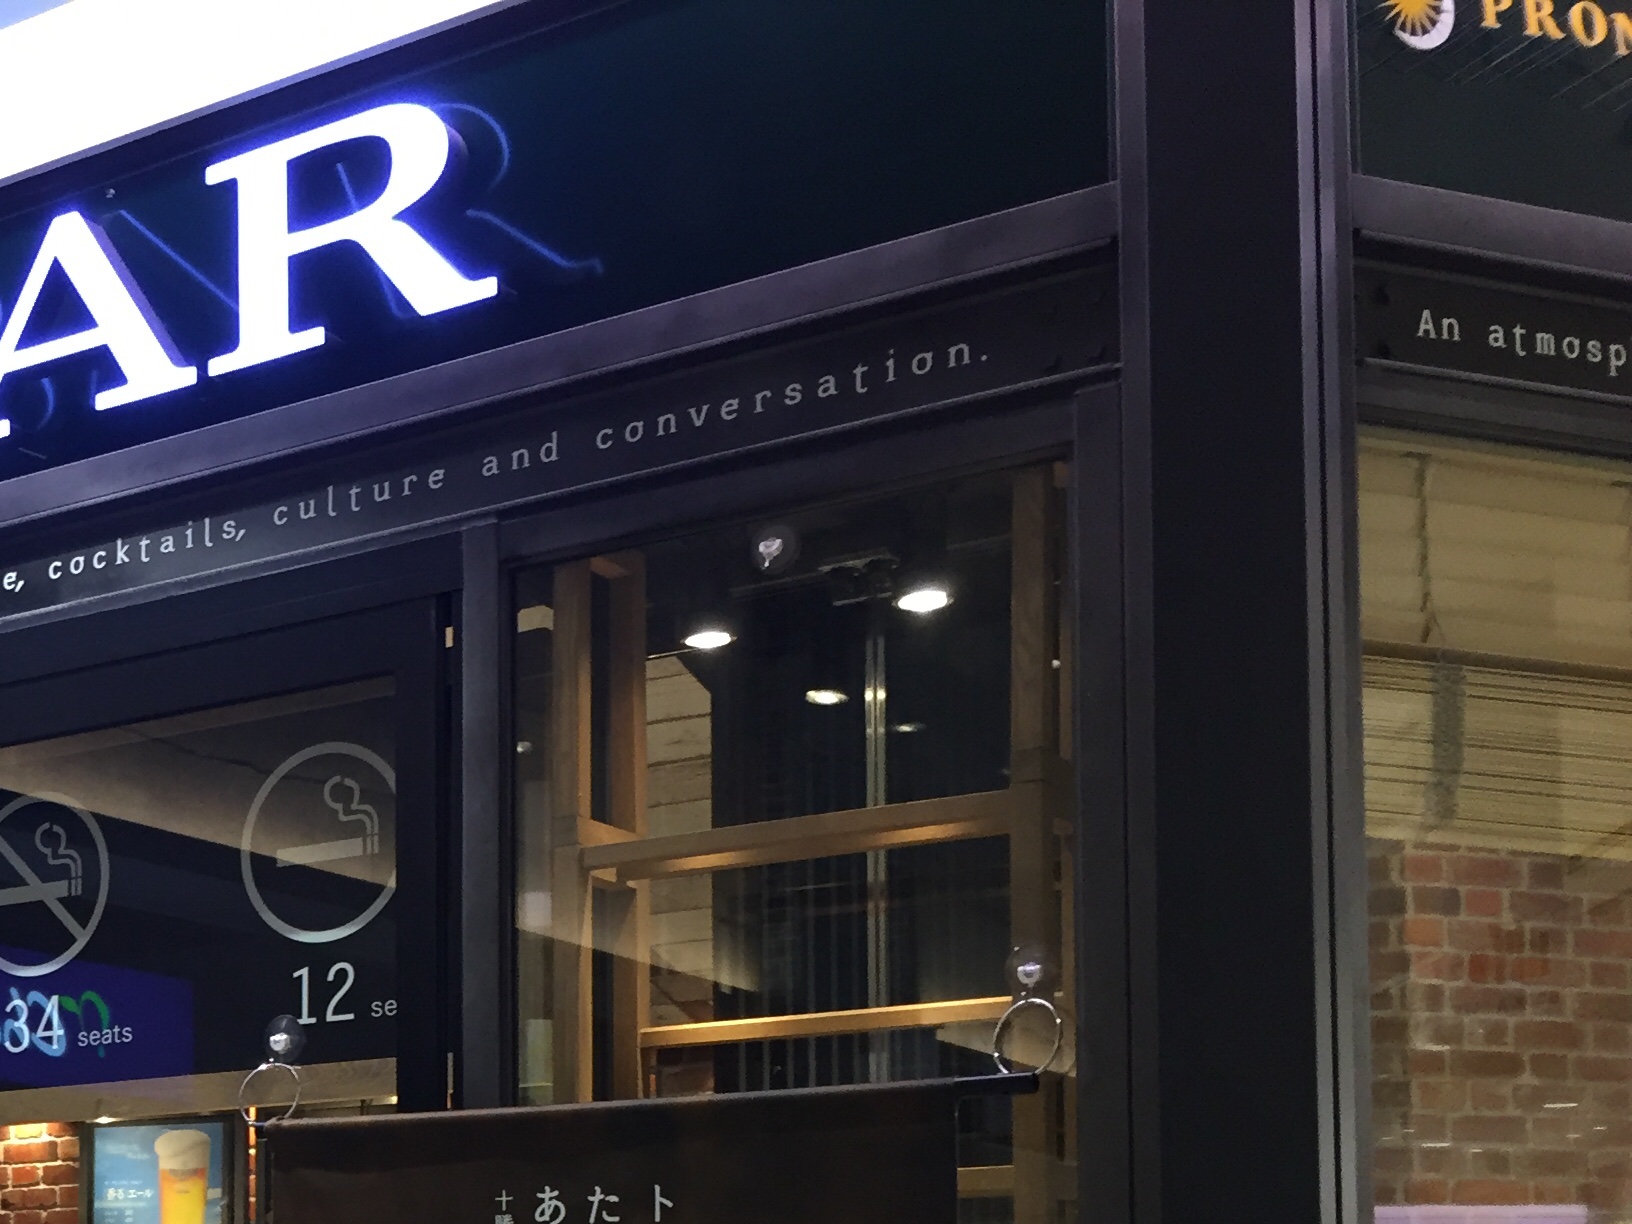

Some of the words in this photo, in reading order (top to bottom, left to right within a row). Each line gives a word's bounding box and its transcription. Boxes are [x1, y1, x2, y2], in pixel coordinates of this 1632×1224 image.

[1416, 308, 1462, 342] An
[1488, 322, 1628, 377] atmosp
[47, 517, 248, 583] cocktails,
[272, 466, 447, 527] culture
[481, 431, 562, 477] and
[595, 341, 990, 452] conversation.
[4, 993, 66, 1054] 34
[76, 1022, 133, 1049] seats
[292, 960, 357, 1026] 12
